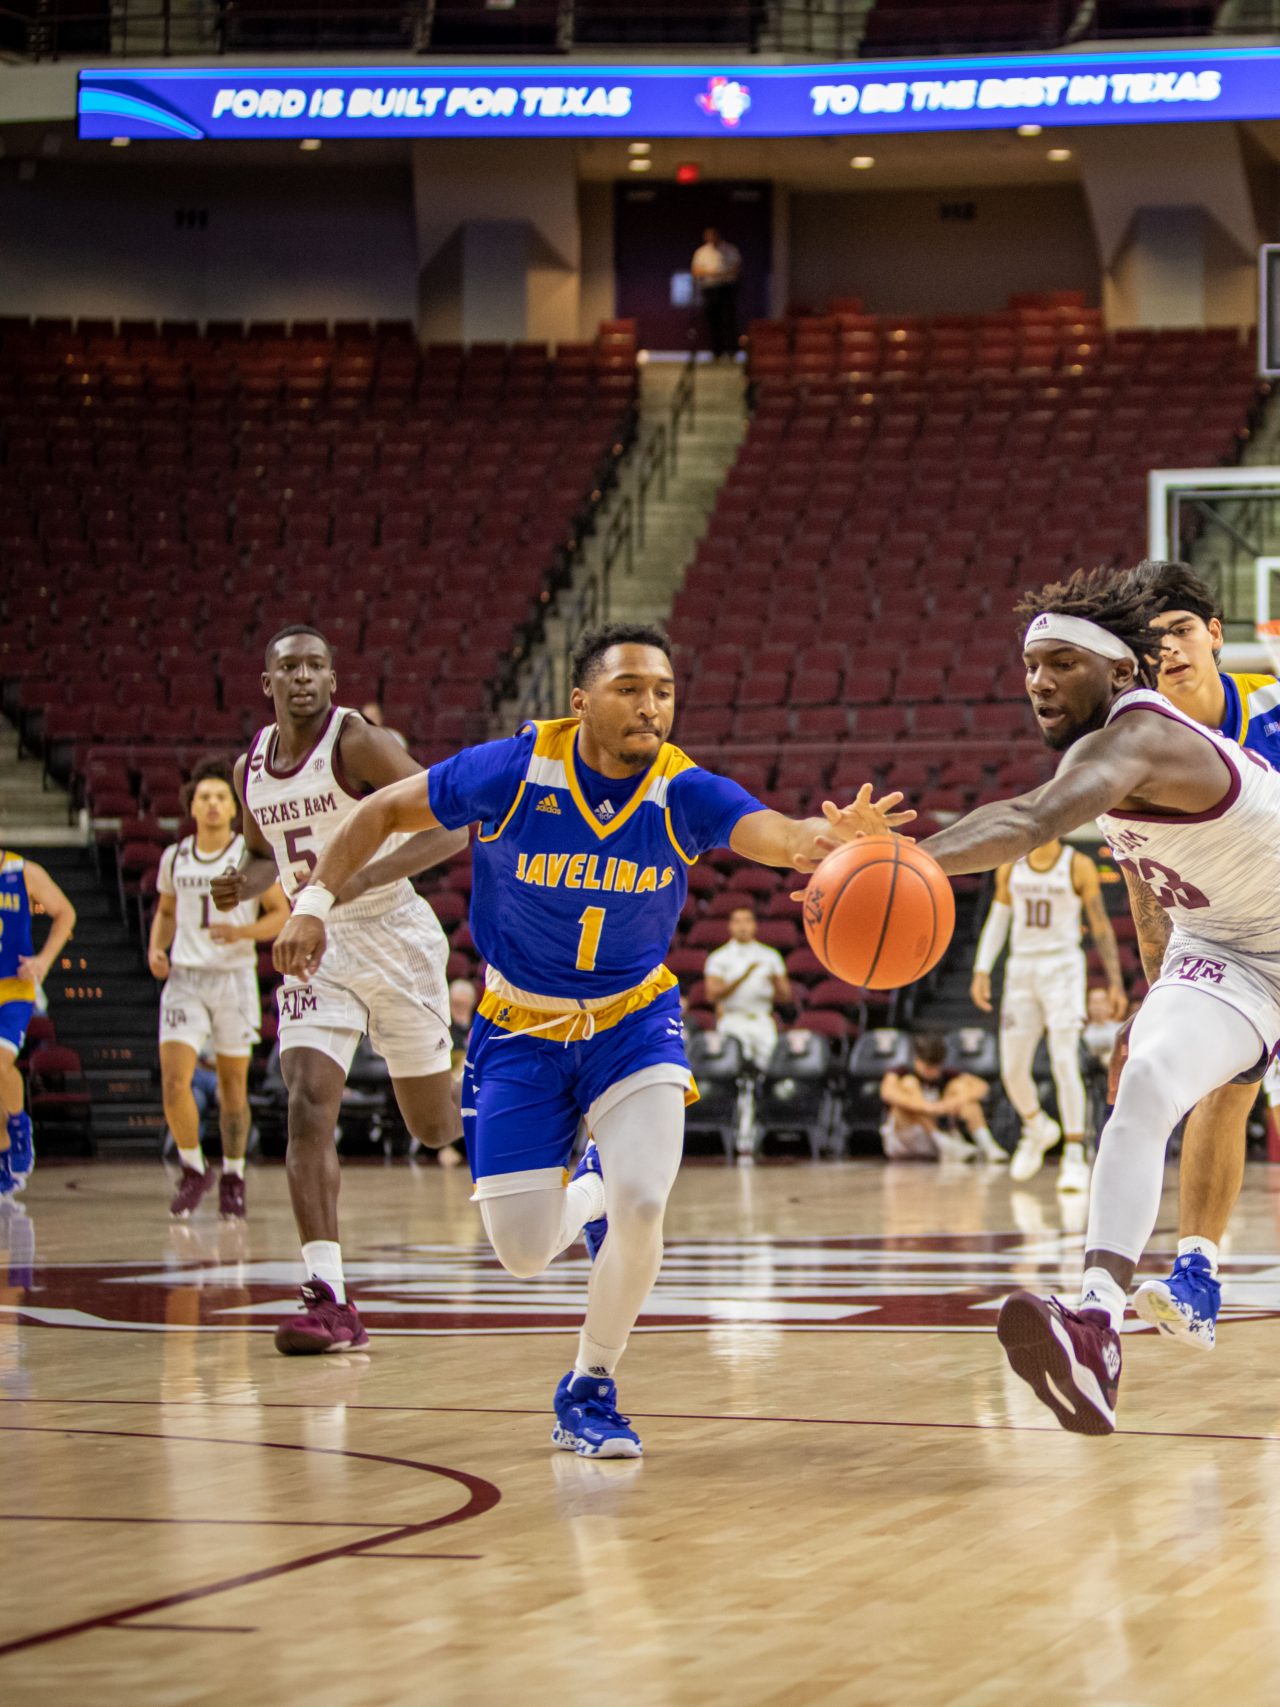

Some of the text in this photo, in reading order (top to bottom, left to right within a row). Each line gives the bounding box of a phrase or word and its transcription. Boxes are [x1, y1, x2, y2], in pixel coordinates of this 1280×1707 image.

[212, 86, 632, 118] FORD IS BUILT FOR TEXAS
[810, 70, 1221, 116] TO BE THE BEST IN TEXAS
[252, 791, 338, 826] TEXAS A&M
[283, 825, 318, 887] 5
[515, 853, 675, 893] JAVELINAS
[1025, 898, 1051, 929] 10
[575, 905, 607, 972] 1
